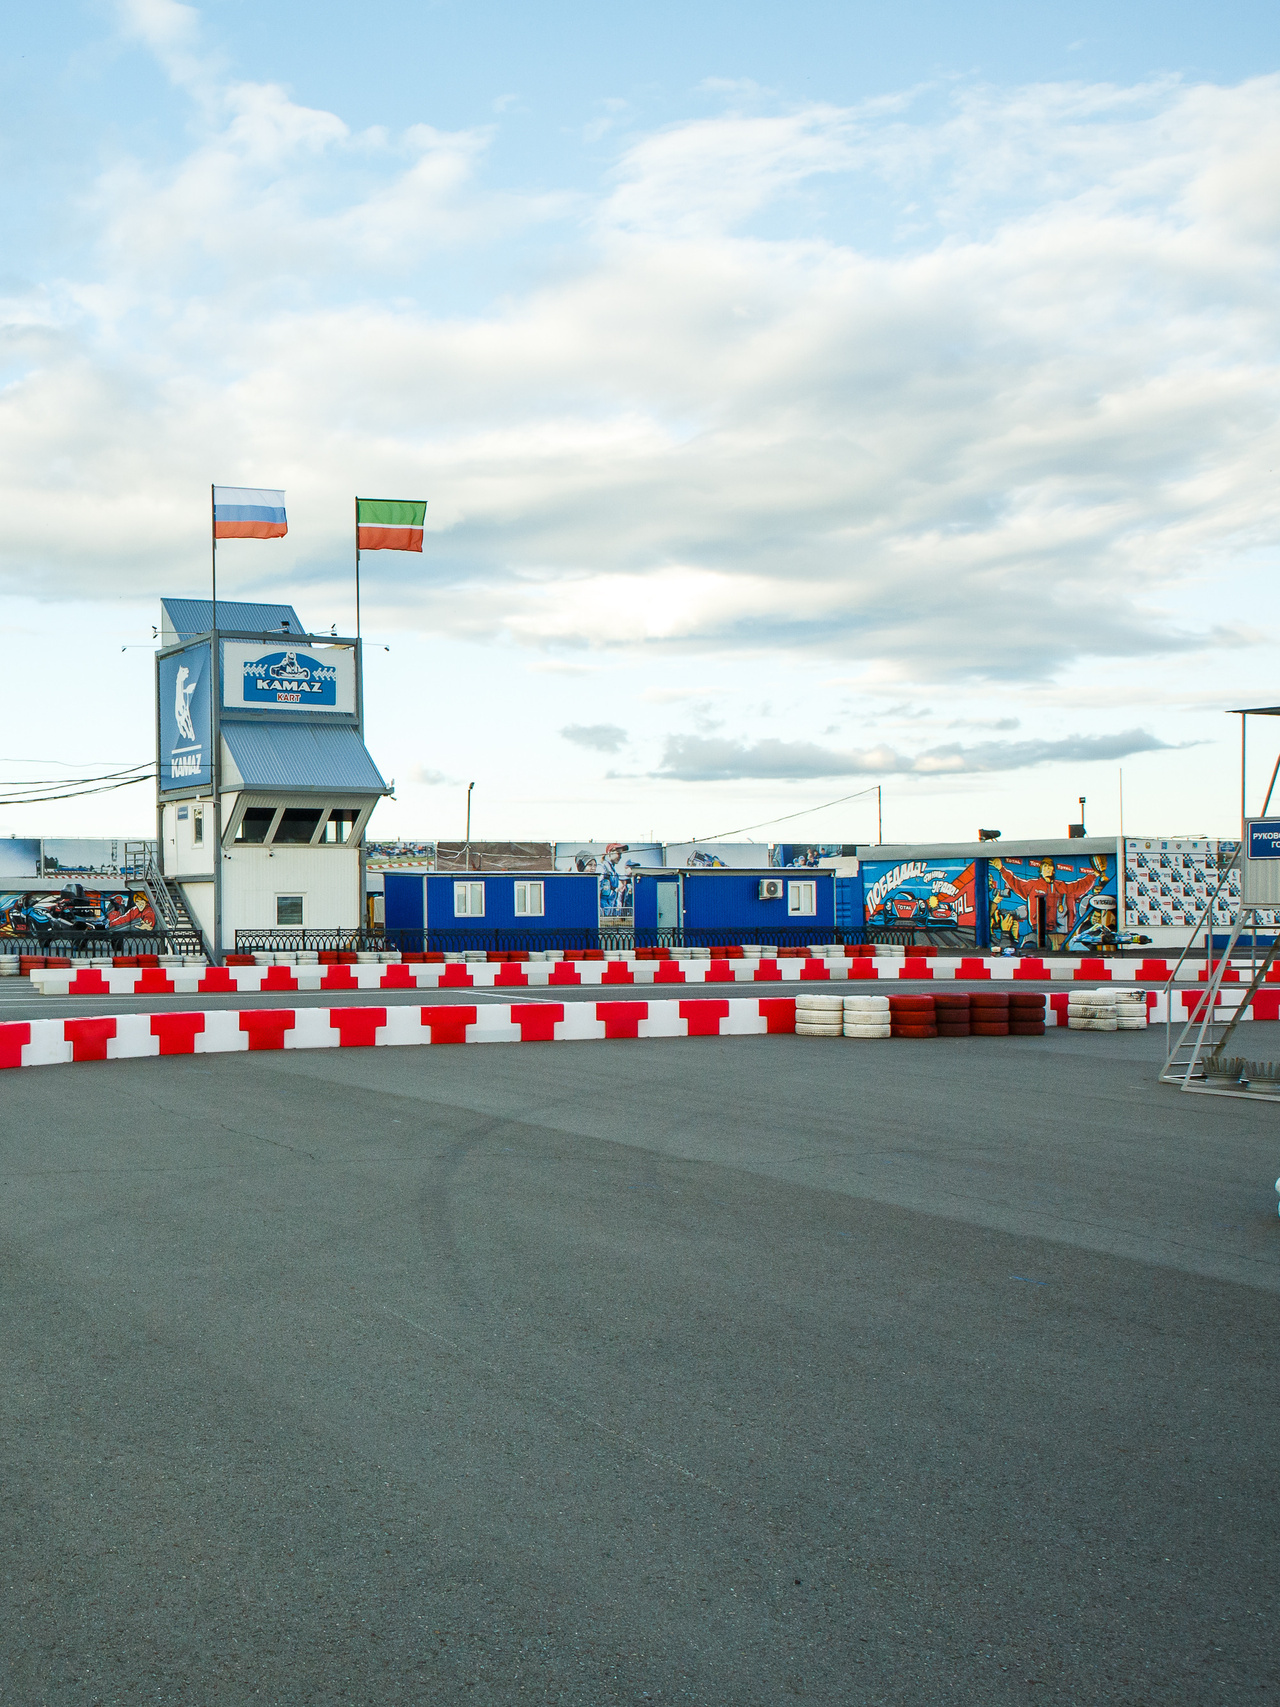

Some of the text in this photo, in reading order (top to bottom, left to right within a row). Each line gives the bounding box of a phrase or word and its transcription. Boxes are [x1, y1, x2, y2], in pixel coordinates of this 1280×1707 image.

[256, 679, 323, 693] KAMAZ
[277, 693, 301, 702] KART
[171, 753, 202, 779] KAMAZ
[1252, 832, 1280, 840] РУКОВ
